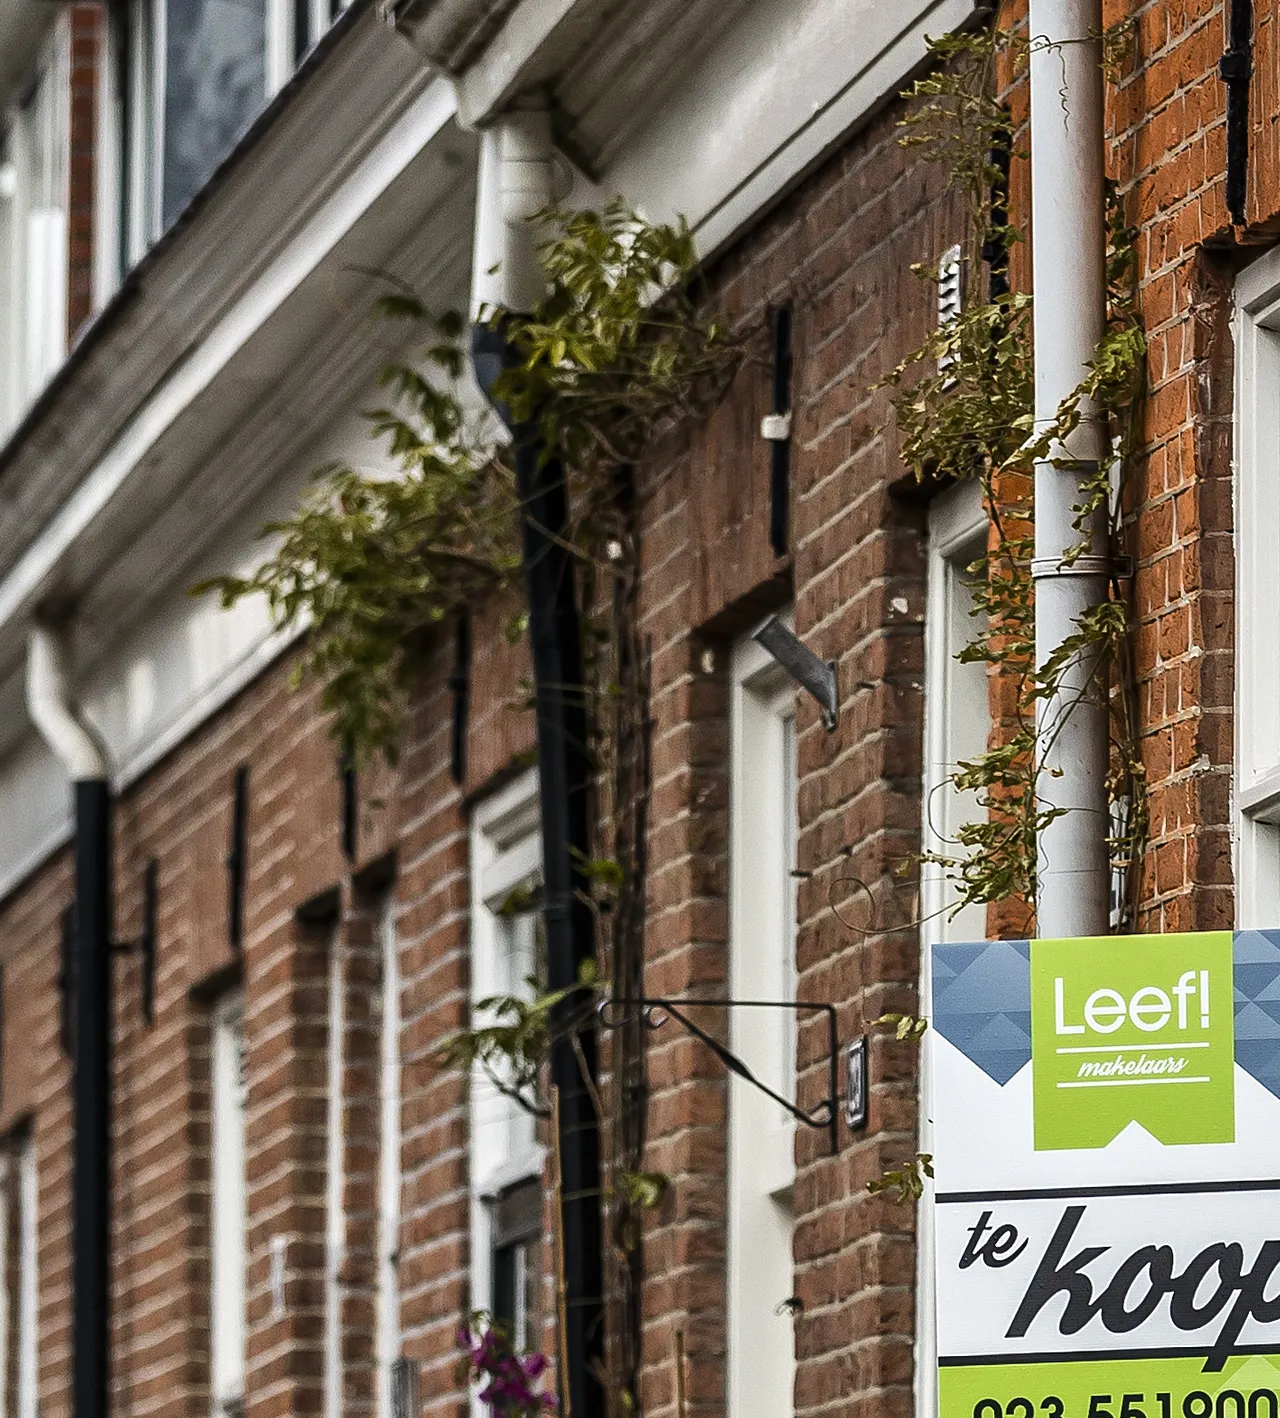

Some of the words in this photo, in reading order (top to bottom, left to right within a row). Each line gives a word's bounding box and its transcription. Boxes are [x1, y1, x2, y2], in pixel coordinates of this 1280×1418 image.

[1054, 969, 1210, 1035] Leef!
[1076, 1053, 1190, 1078] makelaars
[958, 1210, 1030, 1270] te
